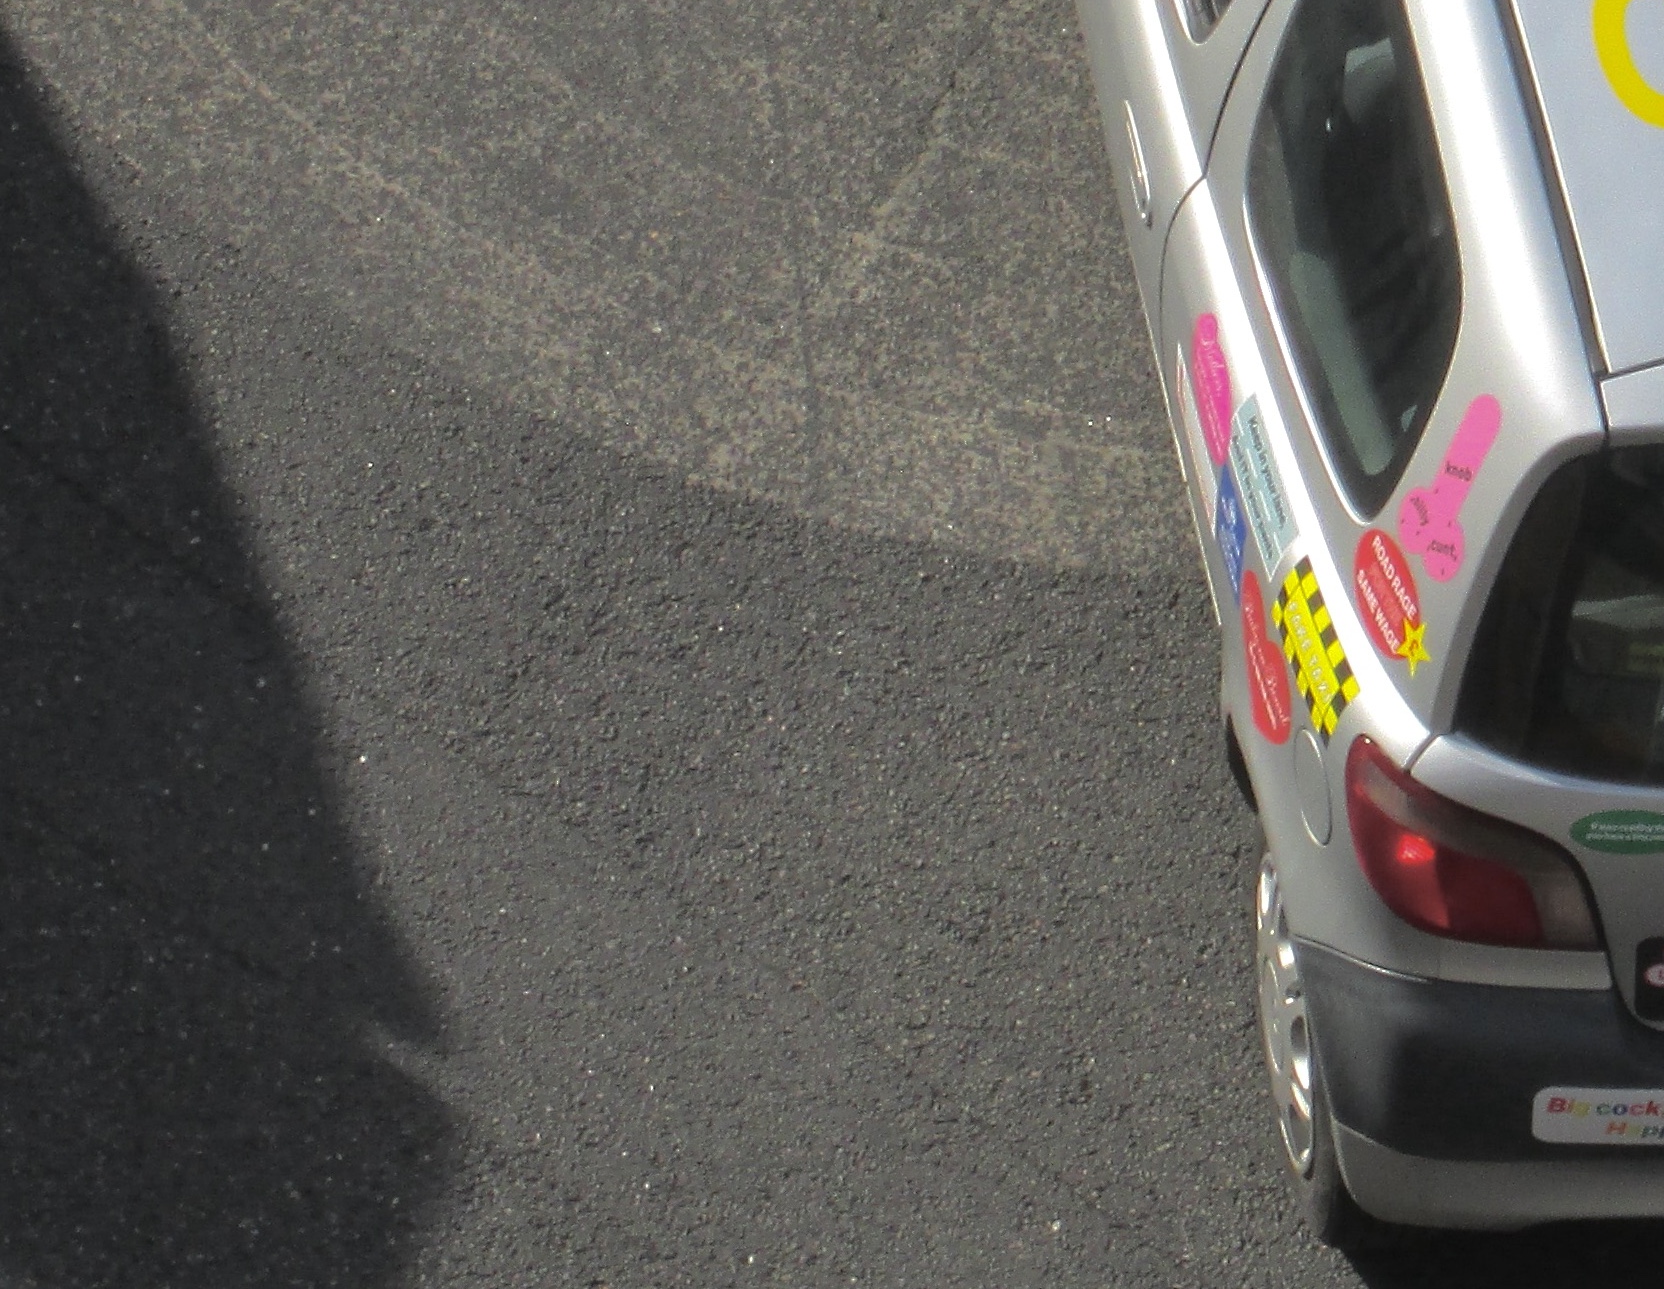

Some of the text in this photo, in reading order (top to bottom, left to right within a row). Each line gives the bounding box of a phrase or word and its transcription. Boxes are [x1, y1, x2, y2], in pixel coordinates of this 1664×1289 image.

[1356, 568, 1379, 615] SAME
[1372, 534, 1395, 581] ROAD
[1390, 575, 1418, 621] RAGE
[1546, 1096, 1591, 1117] Big
